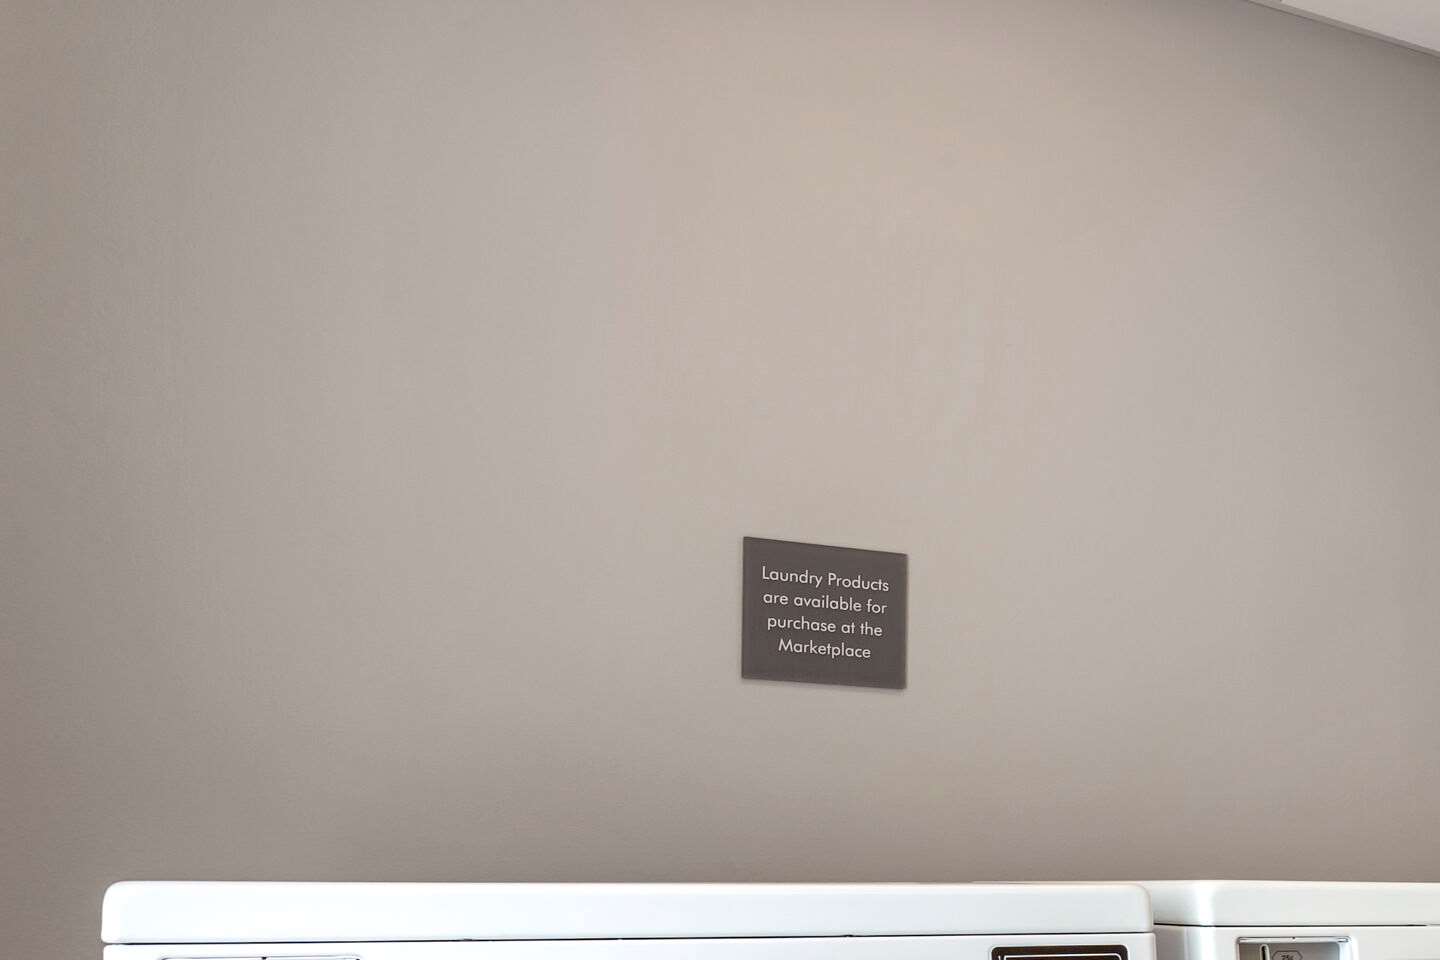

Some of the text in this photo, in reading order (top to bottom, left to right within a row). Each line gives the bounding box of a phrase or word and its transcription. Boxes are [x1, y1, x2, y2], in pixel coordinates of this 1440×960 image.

[762, 566, 889, 591] Laundry Products
[763, 593, 887, 614] are available for
[767, 616, 883, 636] purchase at the
[778, 638, 871, 658] Marketplace
